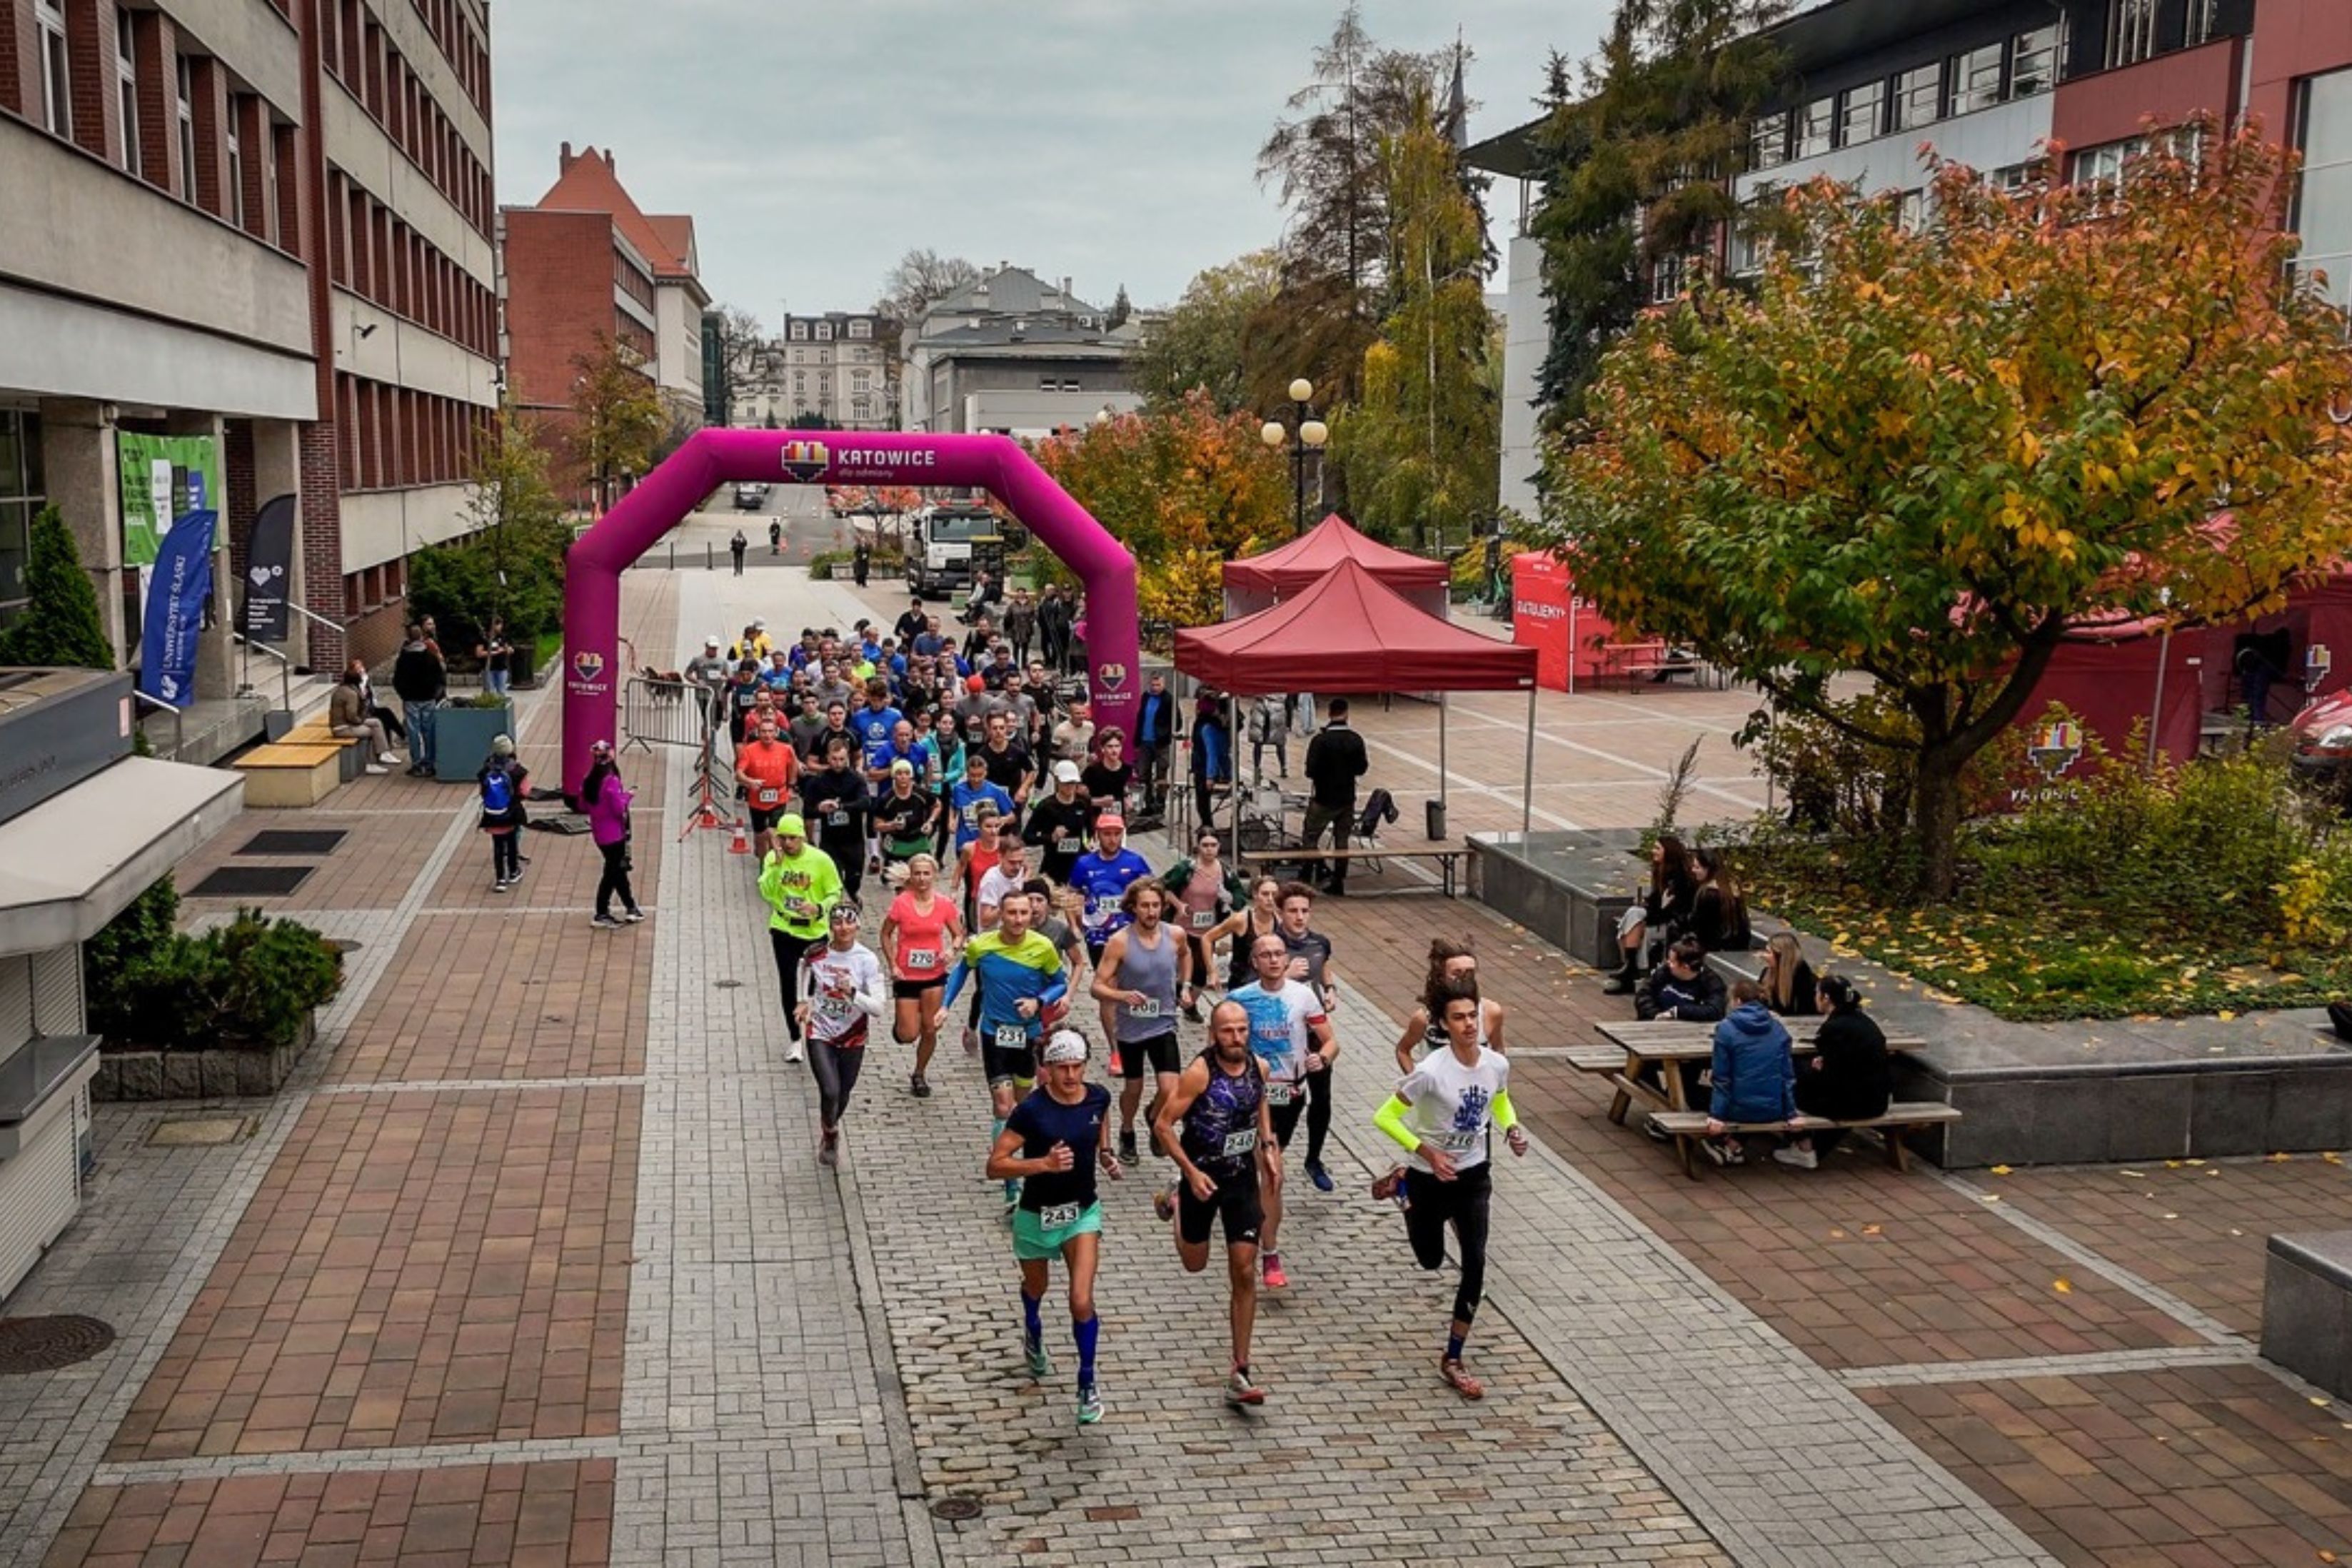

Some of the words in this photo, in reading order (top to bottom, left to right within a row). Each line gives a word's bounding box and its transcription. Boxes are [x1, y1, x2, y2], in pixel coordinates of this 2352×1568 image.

[838, 450, 935, 465] KATOWICE
[999, 1029, 1022, 1042] 231
[1044, 1207, 1076, 1225] 243
